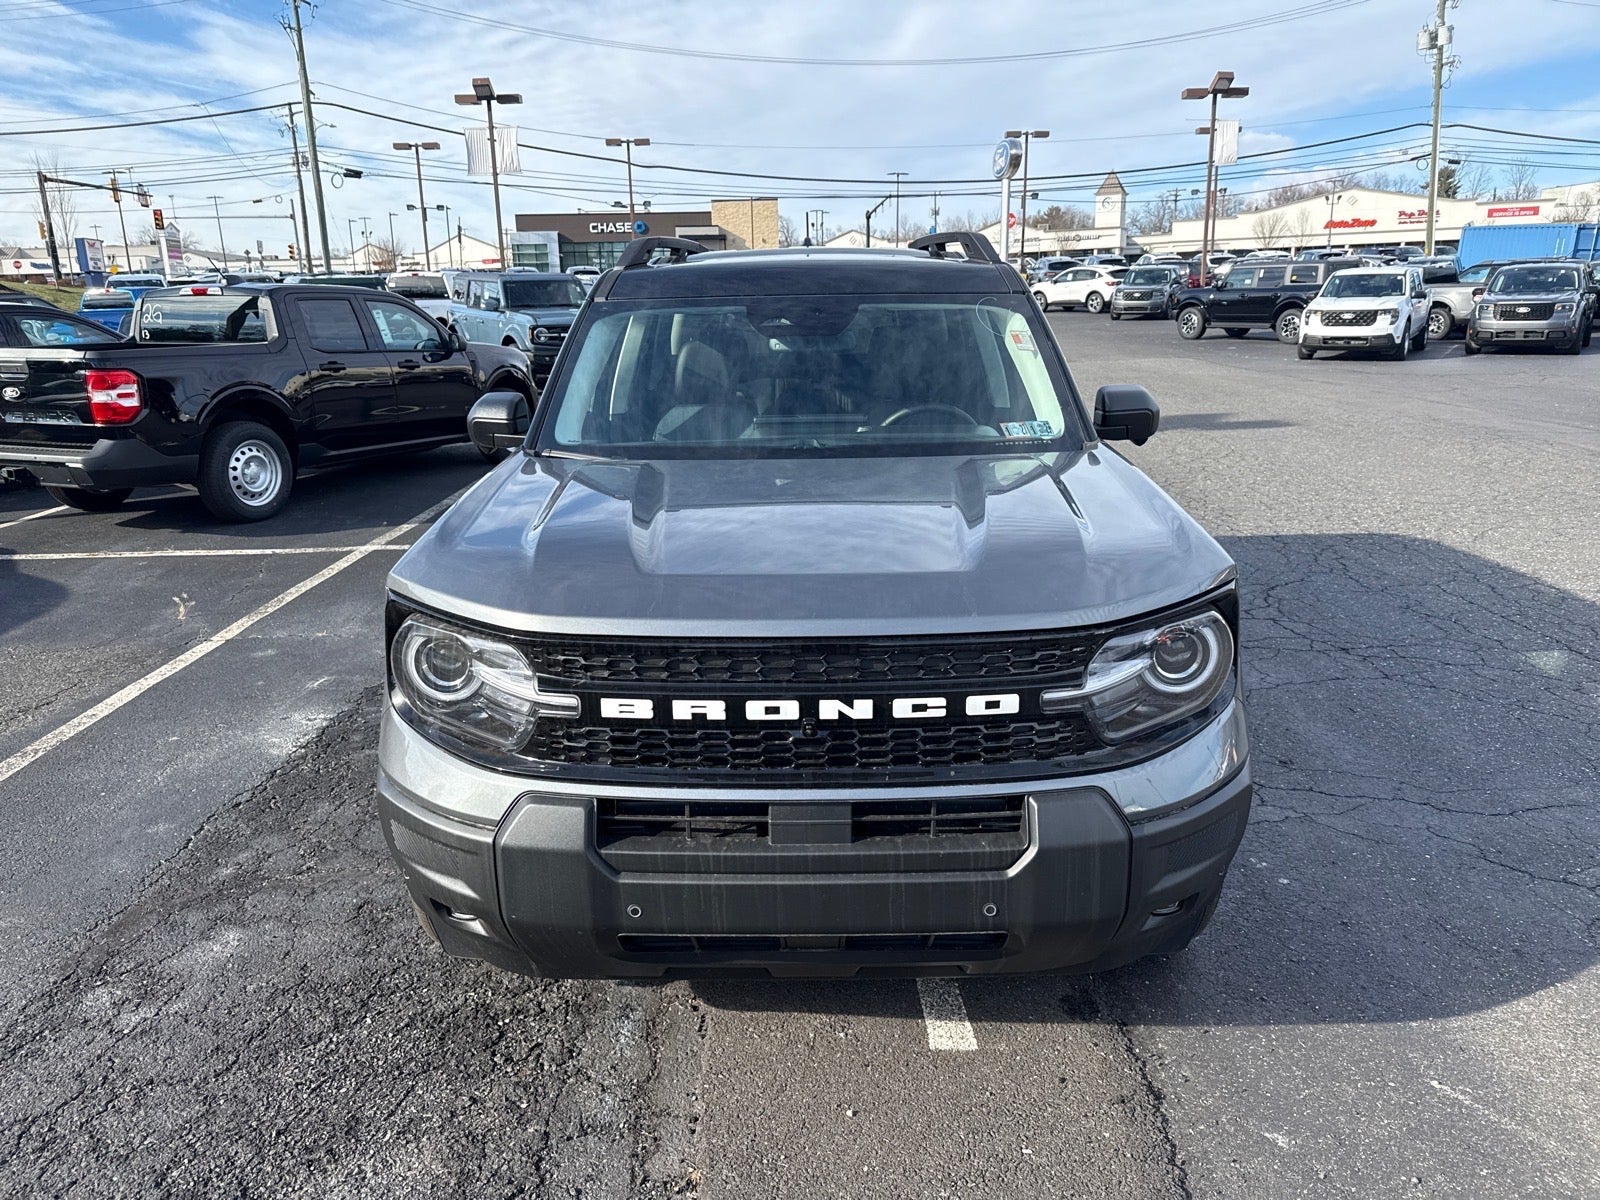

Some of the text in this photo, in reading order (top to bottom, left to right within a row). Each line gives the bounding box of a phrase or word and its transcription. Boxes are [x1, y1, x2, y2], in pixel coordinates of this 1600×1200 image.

[589, 222, 633, 233] CHASE
[142, 303, 163, 324] 26
[600, 693, 1020, 720] BRONCO
